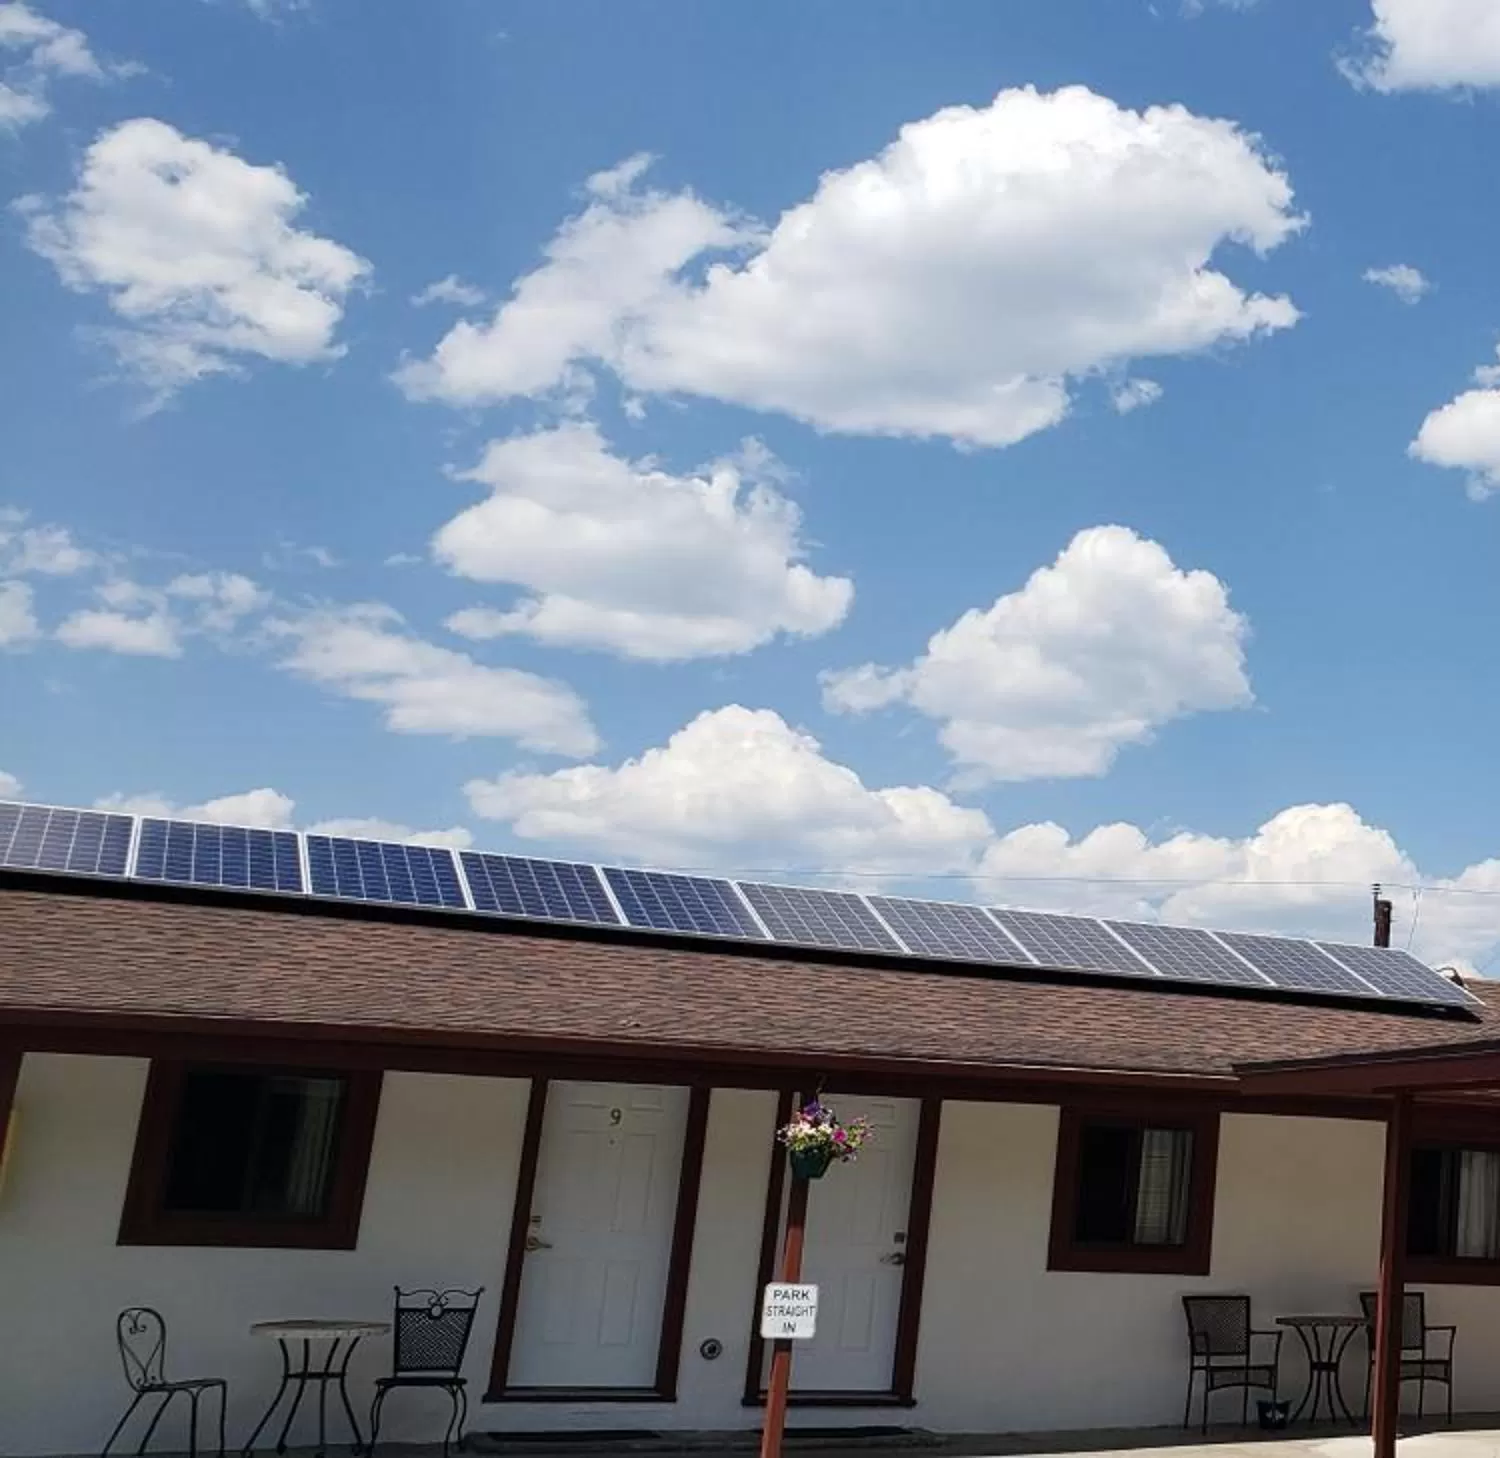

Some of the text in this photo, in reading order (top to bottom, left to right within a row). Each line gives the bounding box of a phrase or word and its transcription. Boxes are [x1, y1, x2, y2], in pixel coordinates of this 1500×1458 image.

[610, 1108, 622, 1126] 9
[773, 1289, 810, 1301] PARK
[766, 1305, 816, 1317] STRAIGHT
[782, 1322, 797, 1333] IN
